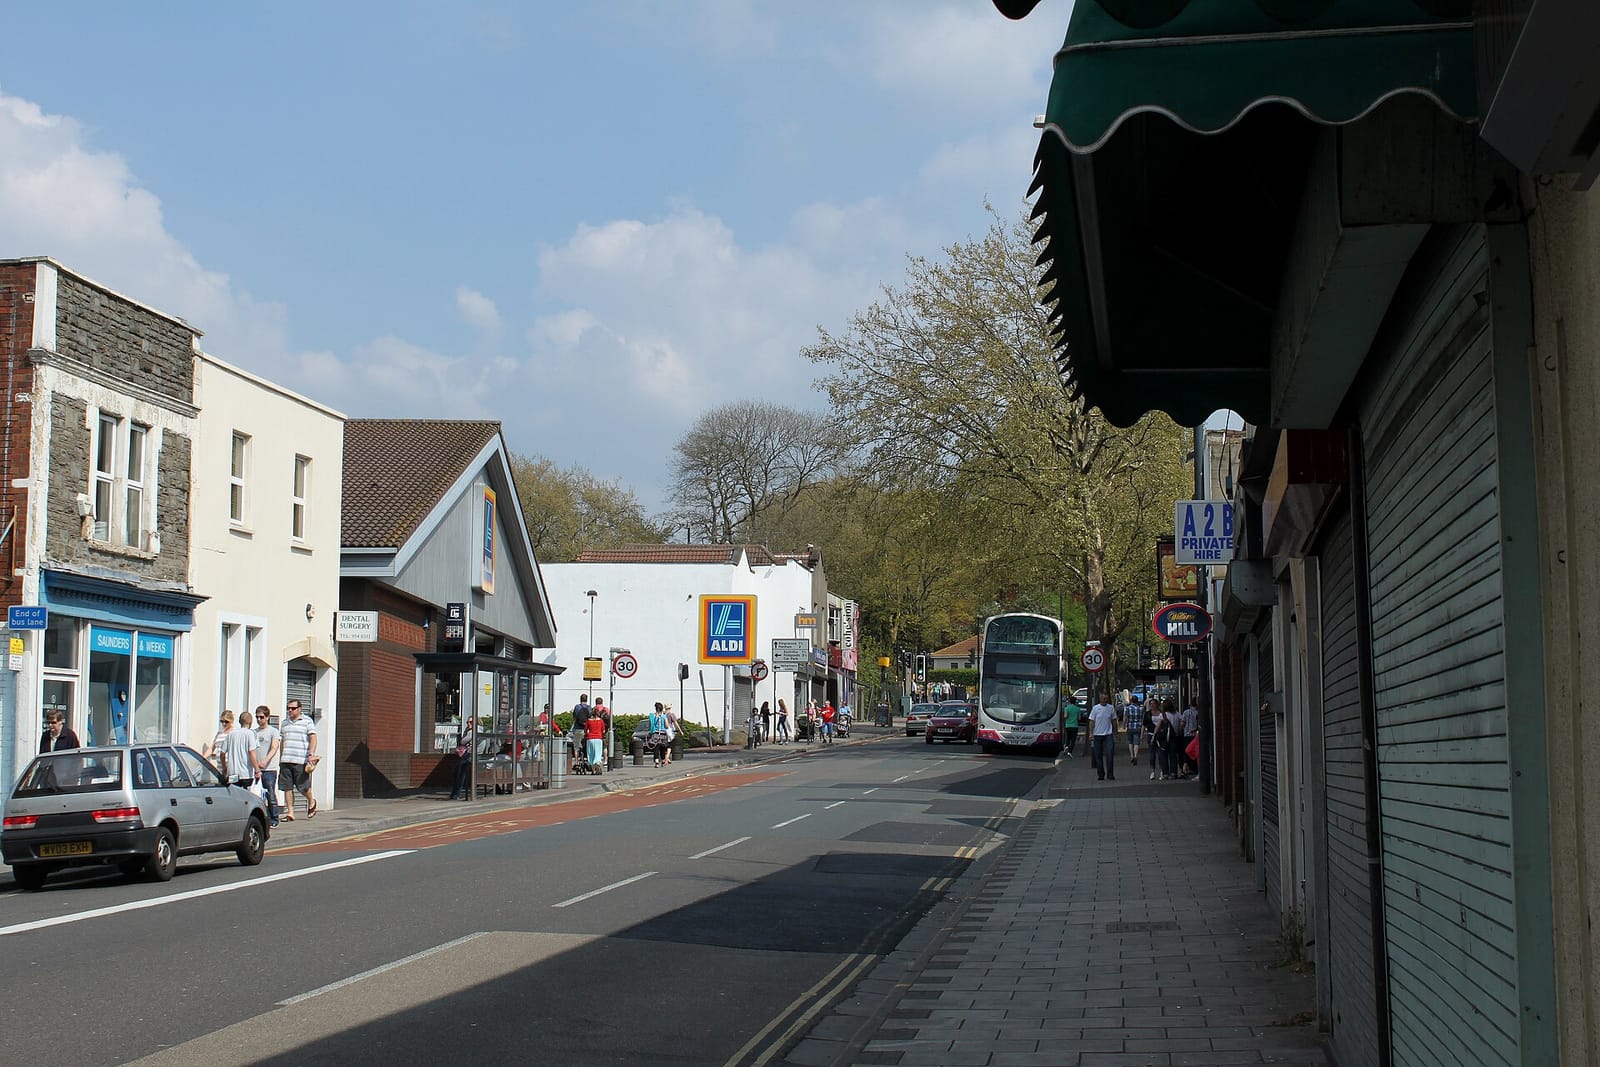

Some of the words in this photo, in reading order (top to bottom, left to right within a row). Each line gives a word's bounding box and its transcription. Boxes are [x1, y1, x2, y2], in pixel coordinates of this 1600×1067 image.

[1183, 504, 1196, 537] A
[1204, 503, 1214, 537] 2
[1181, 538, 1233, 549] PRIVATE
[1194, 550, 1221, 559] HIRE
[798, 615, 817, 625] hm
[1167, 622, 1198, 636] HILL
[97, 634, 130, 650] SAUNDERS
[139, 639, 144, 651] &
[146, 641, 166, 654] WEEKS
[710, 639, 744, 652] ALDI
[1085, 654, 1103, 665] 30
[618, 661, 634, 671] 30
[42, 844, 67, 856] WV03
[70, 842, 89, 853] EXH
